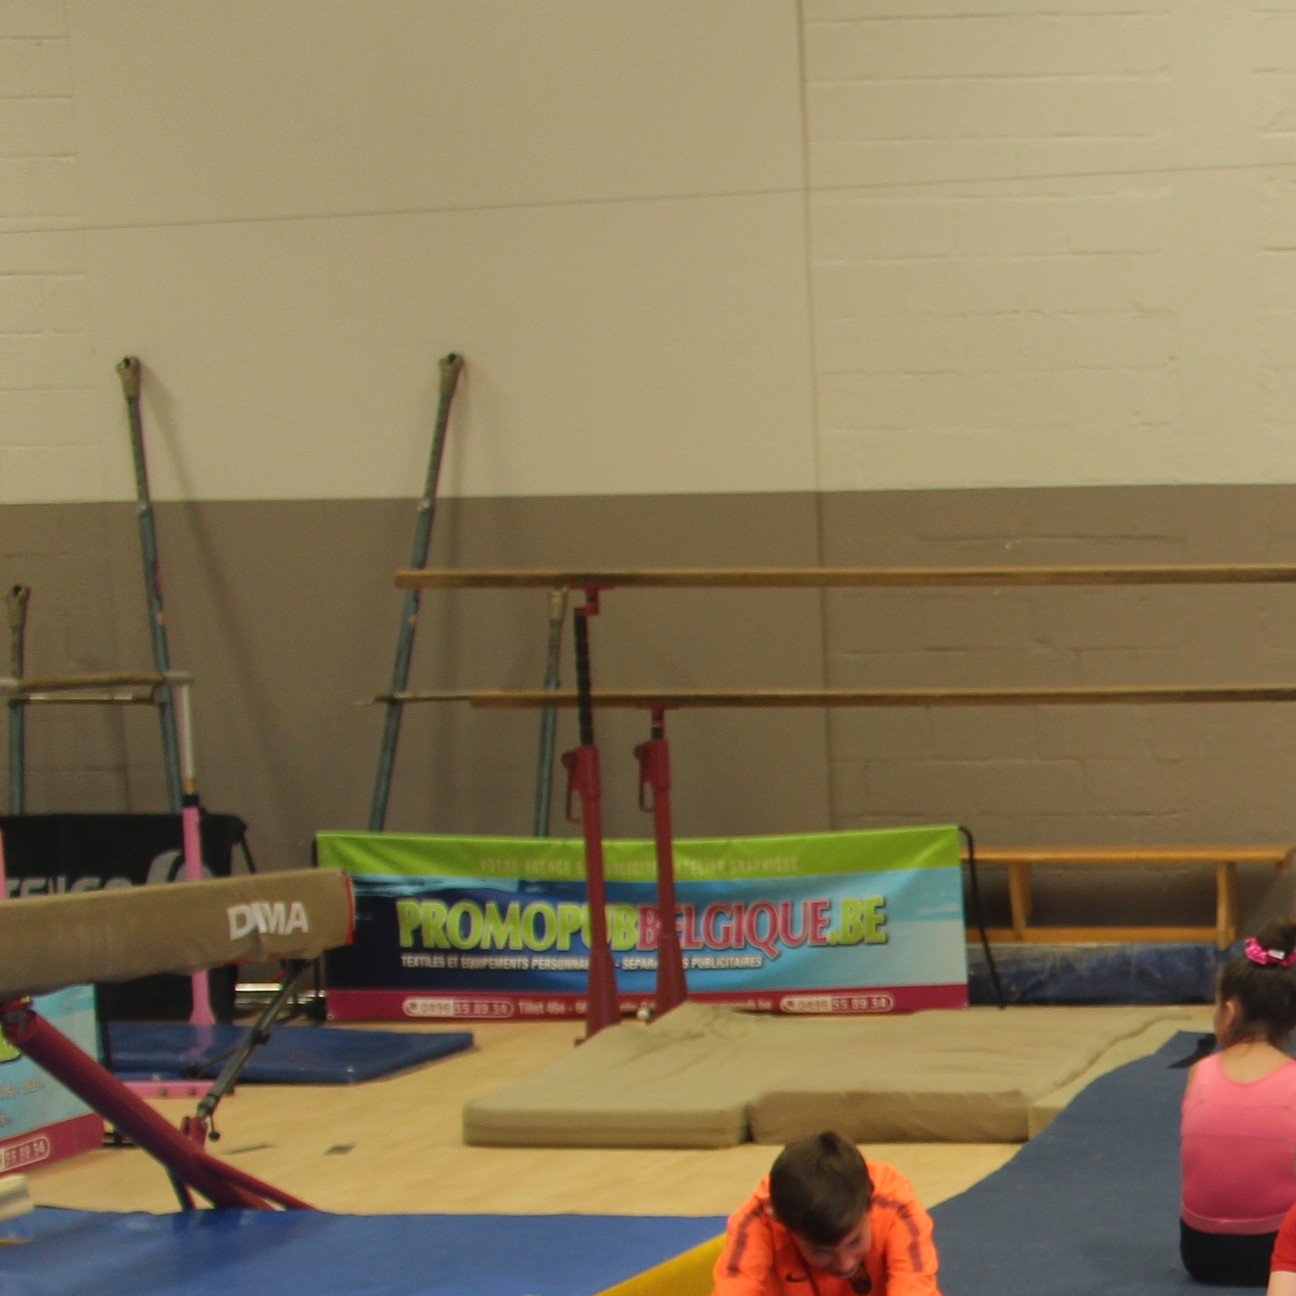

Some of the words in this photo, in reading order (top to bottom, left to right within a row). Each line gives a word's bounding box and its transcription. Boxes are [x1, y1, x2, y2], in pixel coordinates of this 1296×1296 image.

[402, 955, 444, 969] TEXTILES
[447, 955, 458, 969] ET
[461, 955, 528, 971] EQUIPEMENTS
[692, 955, 762, 970] PUBLICITAIRES
